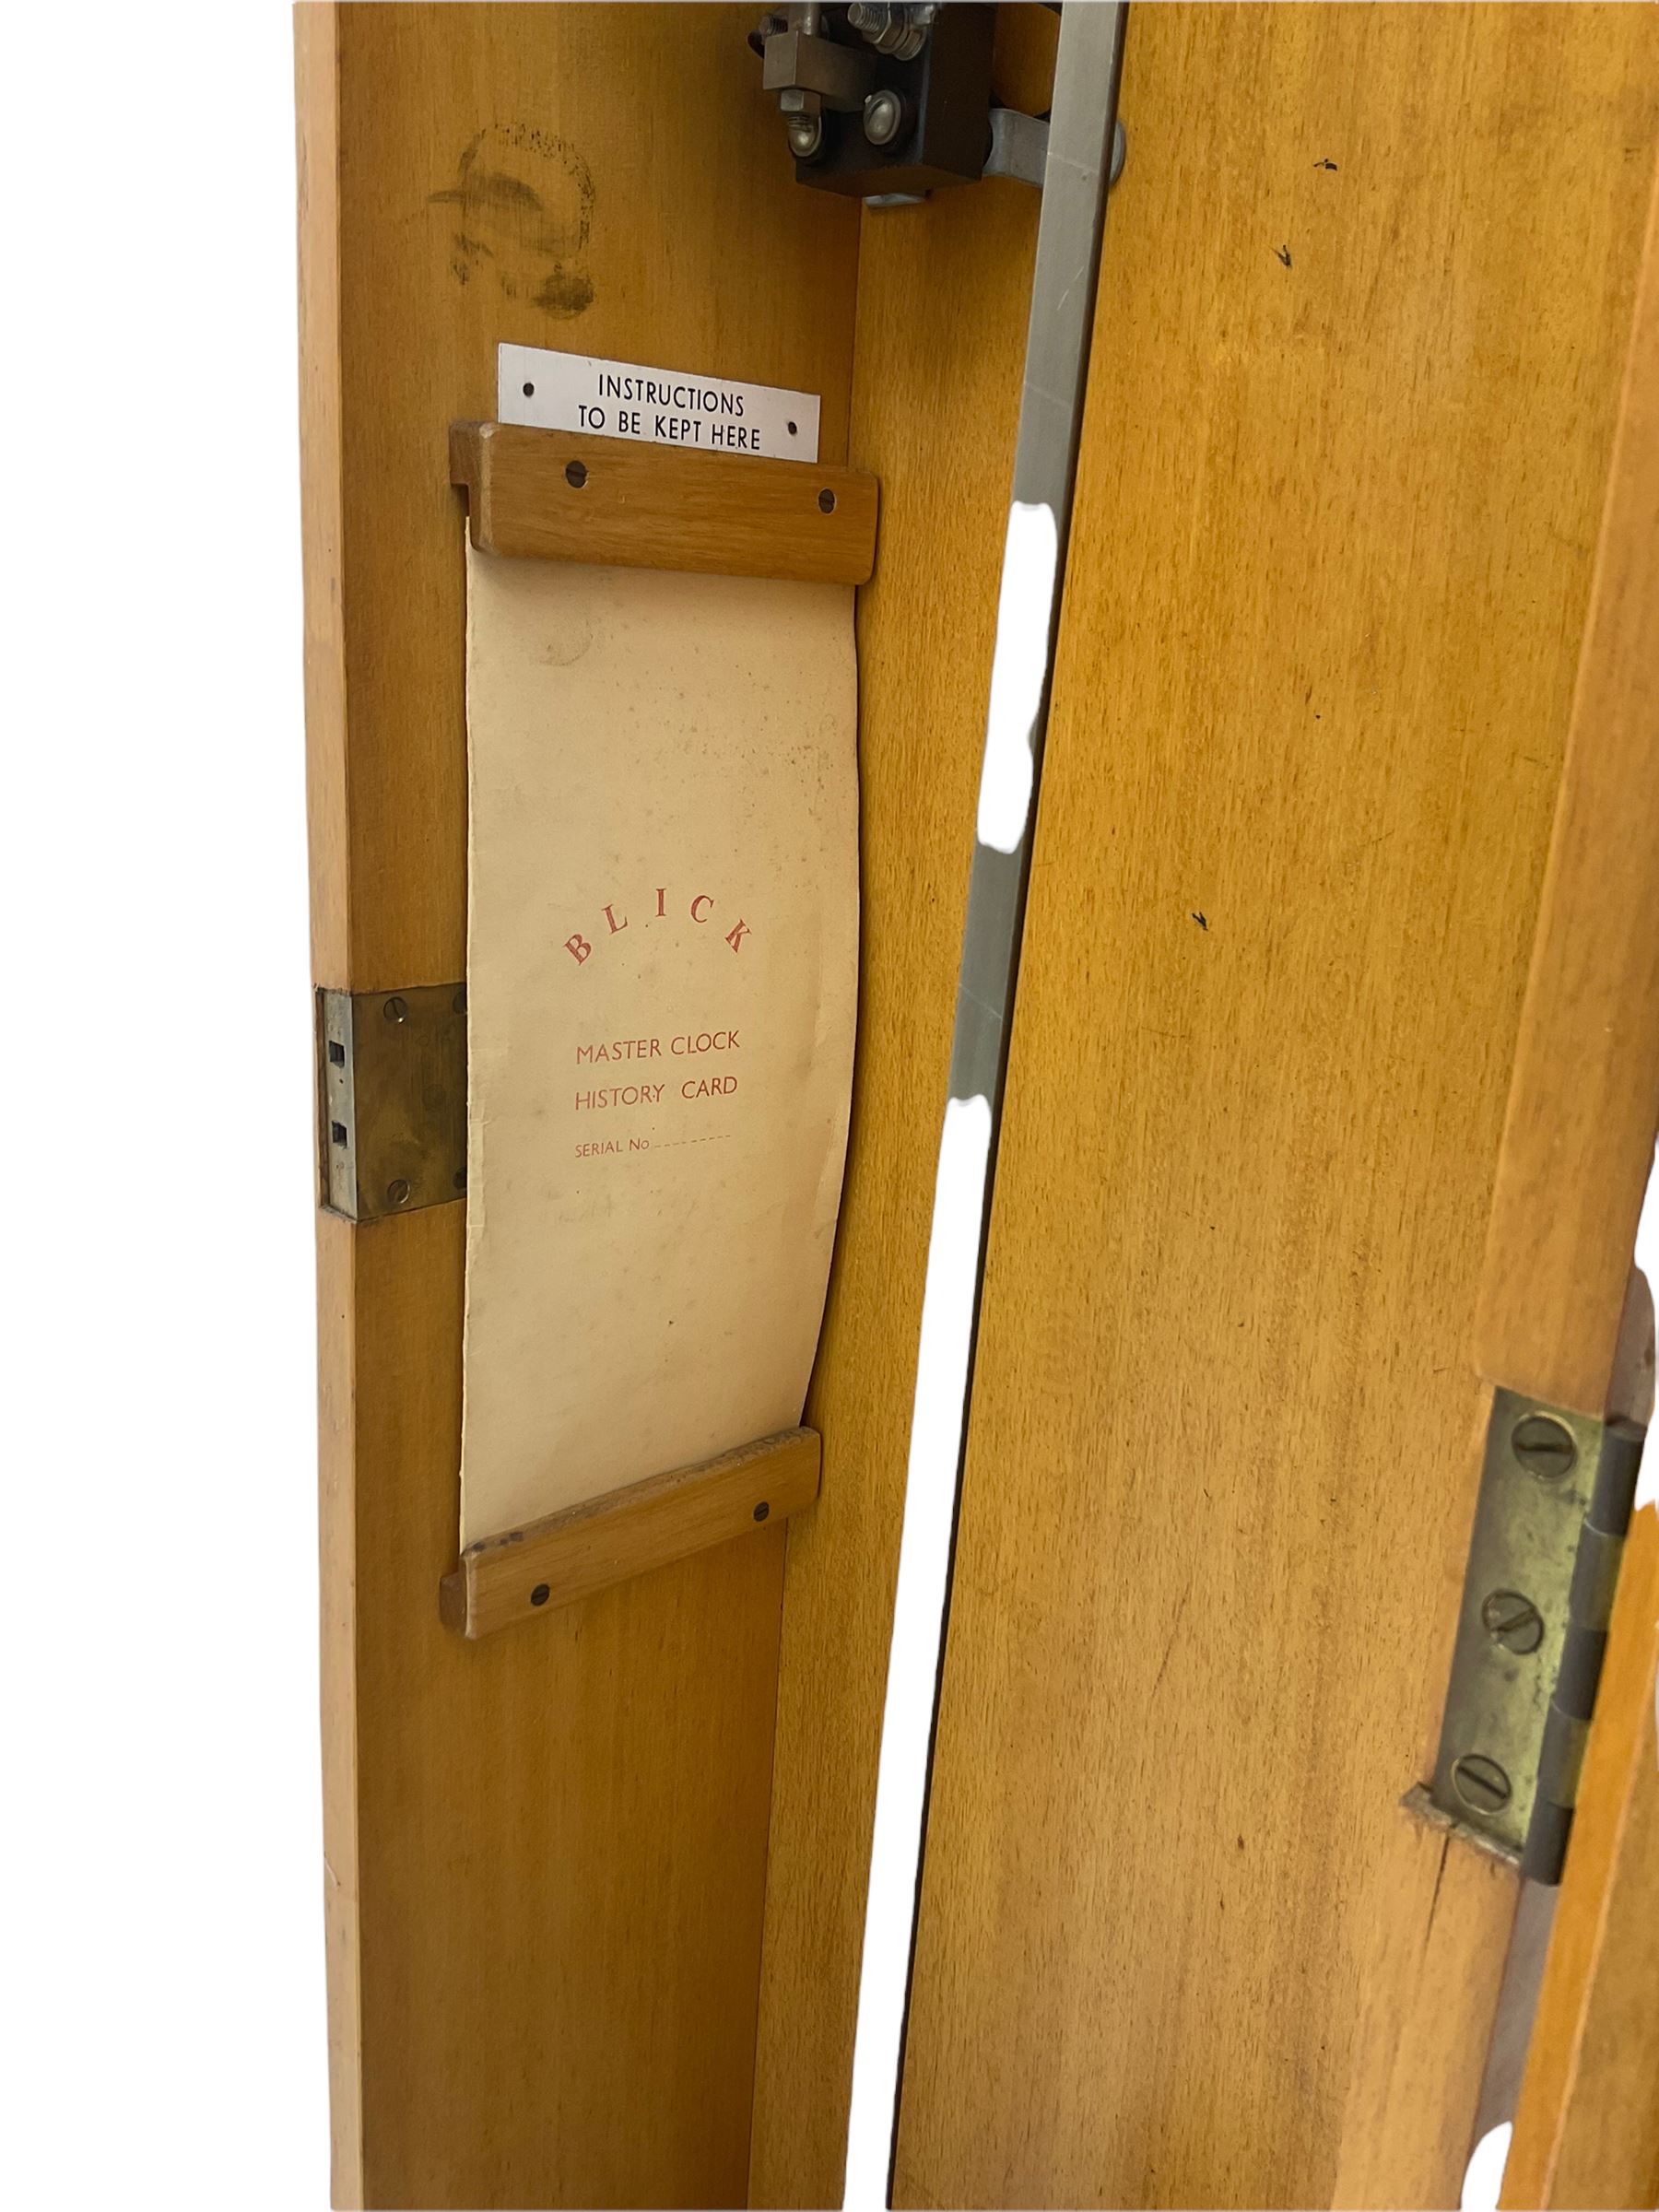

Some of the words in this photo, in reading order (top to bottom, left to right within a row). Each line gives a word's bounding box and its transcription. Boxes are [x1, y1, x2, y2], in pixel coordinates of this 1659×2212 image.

[598, 373, 745, 417] INSTRUCTIONS
[578, 405, 606, 429] TO
[618, 410, 641, 435] BE
[655, 415, 701, 442] KEPT
[712, 424, 760, 451] HERE
[562, 888, 752, 966] BLICK
[576, 1039, 662, 1065] MASTER
[670, 1030, 740, 1055] CLOCK
[575, 1084, 665, 1111] HISTORY
[681, 1076, 738, 1100] CARD
[574, 1140, 623, 1159] SERIAL
